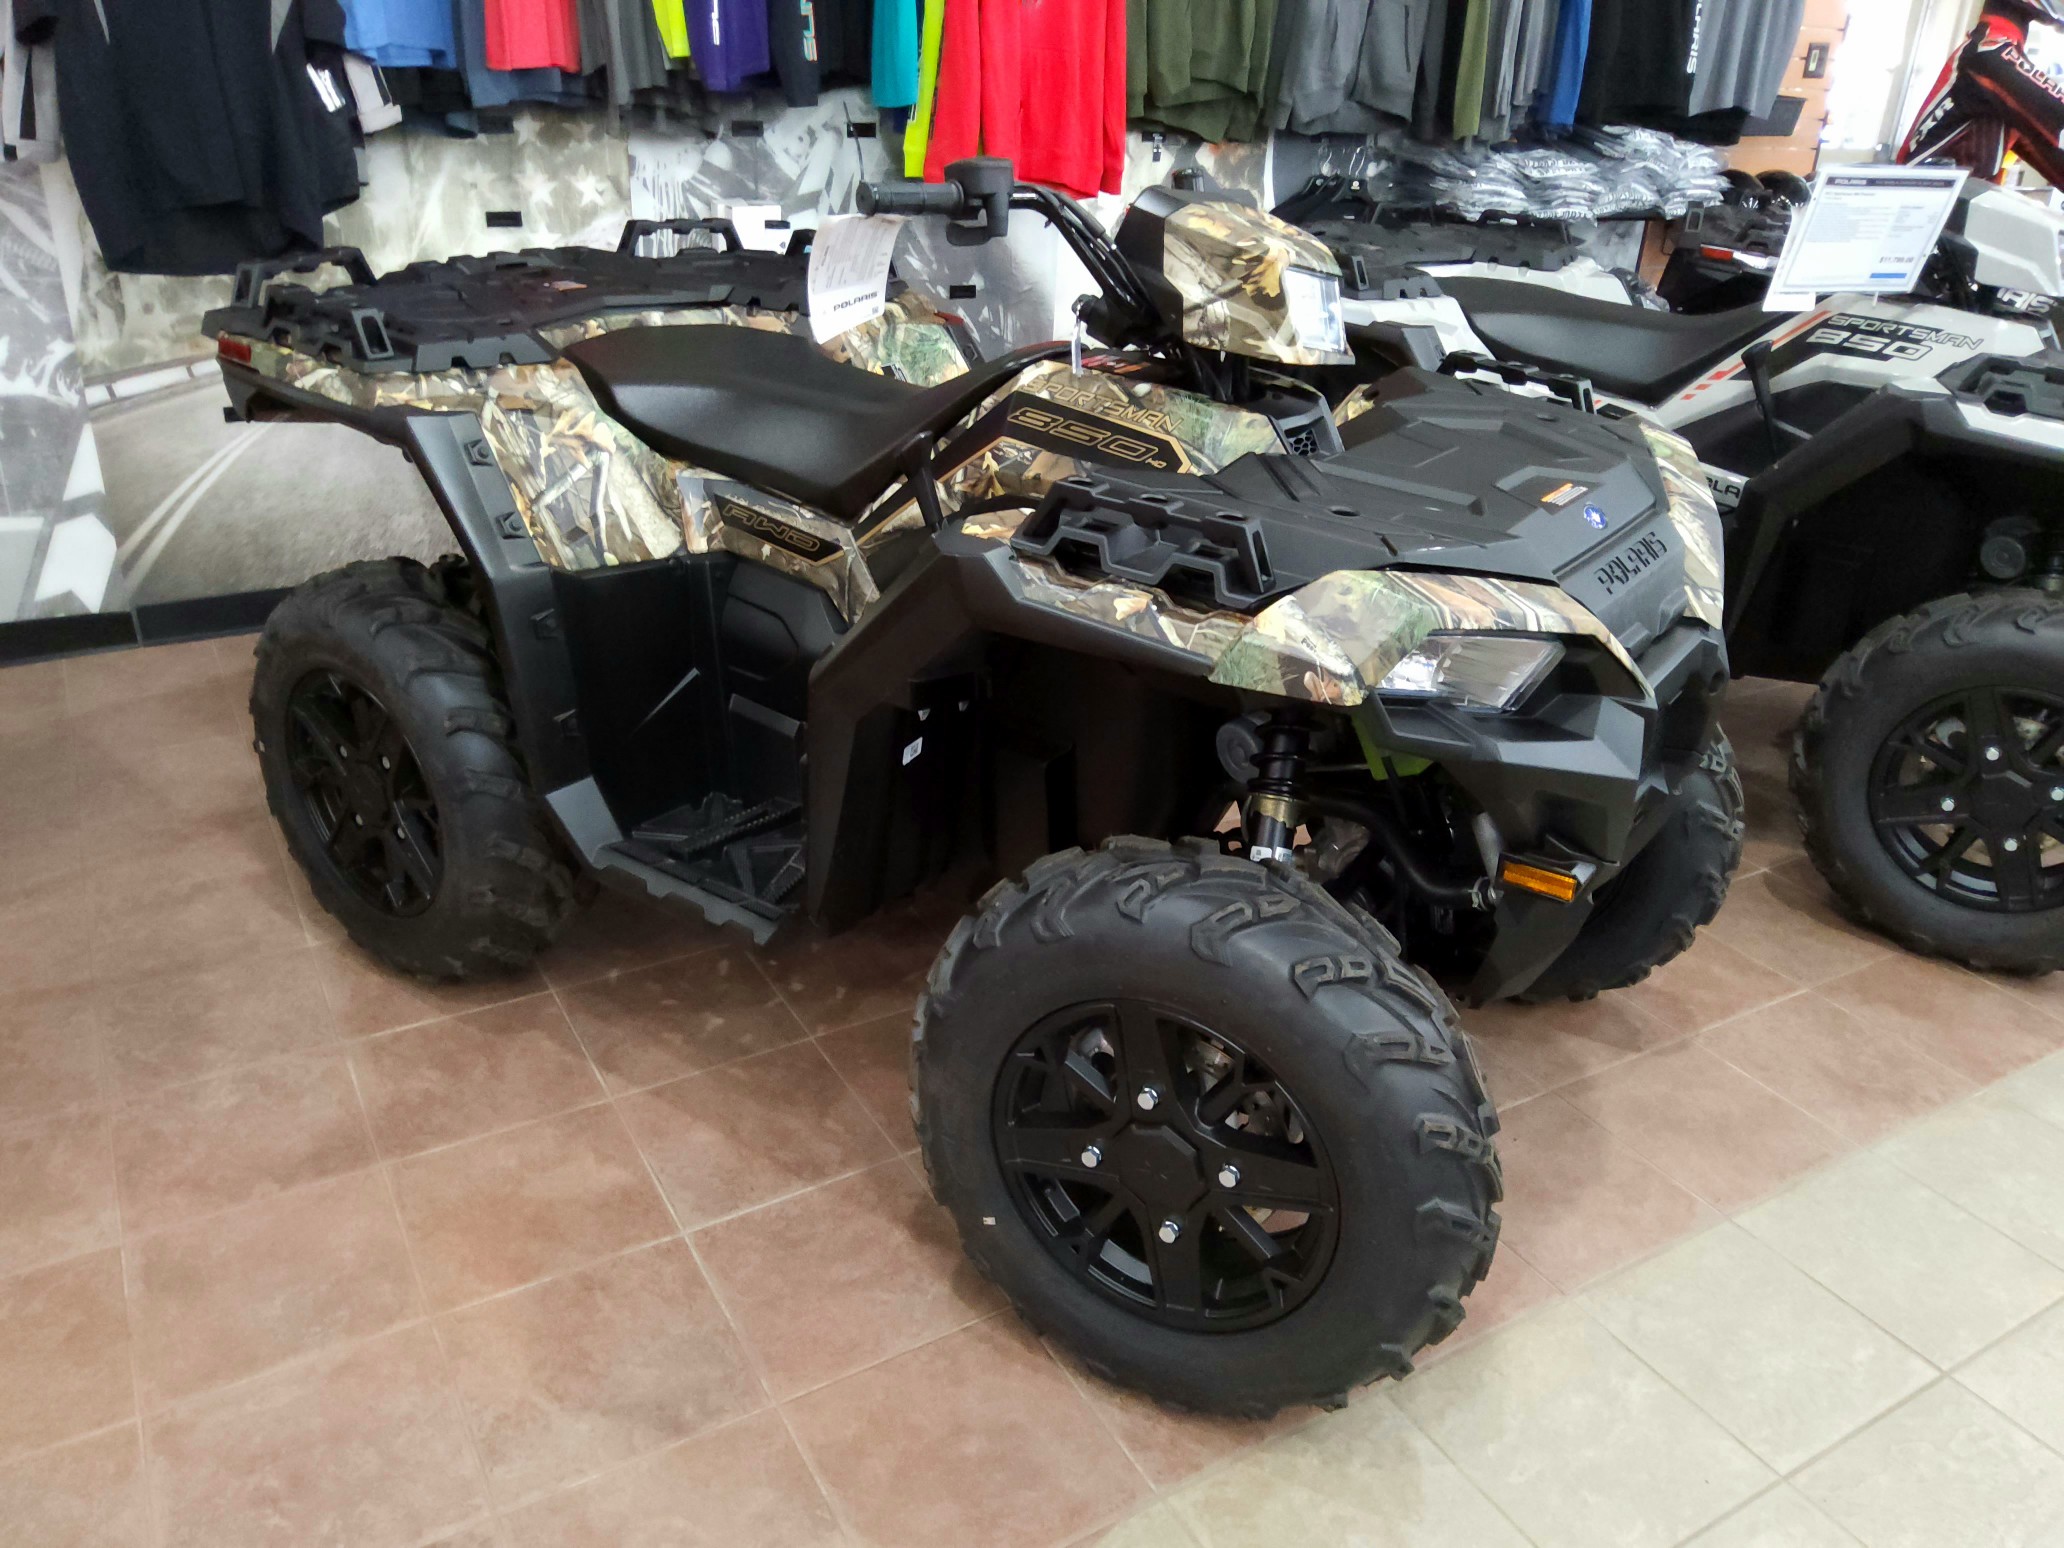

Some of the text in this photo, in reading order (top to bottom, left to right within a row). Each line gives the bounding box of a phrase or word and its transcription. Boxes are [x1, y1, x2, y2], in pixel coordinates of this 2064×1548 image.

[833, 291, 878, 312] POLARIS
[1806, 328, 1933, 361] 850
[1827, 314, 1984, 350] SPORTSMAN
[1021, 378, 1184, 434] SPORTSMAN
[1007, 407, 1159, 462] 850
[722, 503, 821, 552] AWD
[1593, 531, 1668, 595] POLARIS
